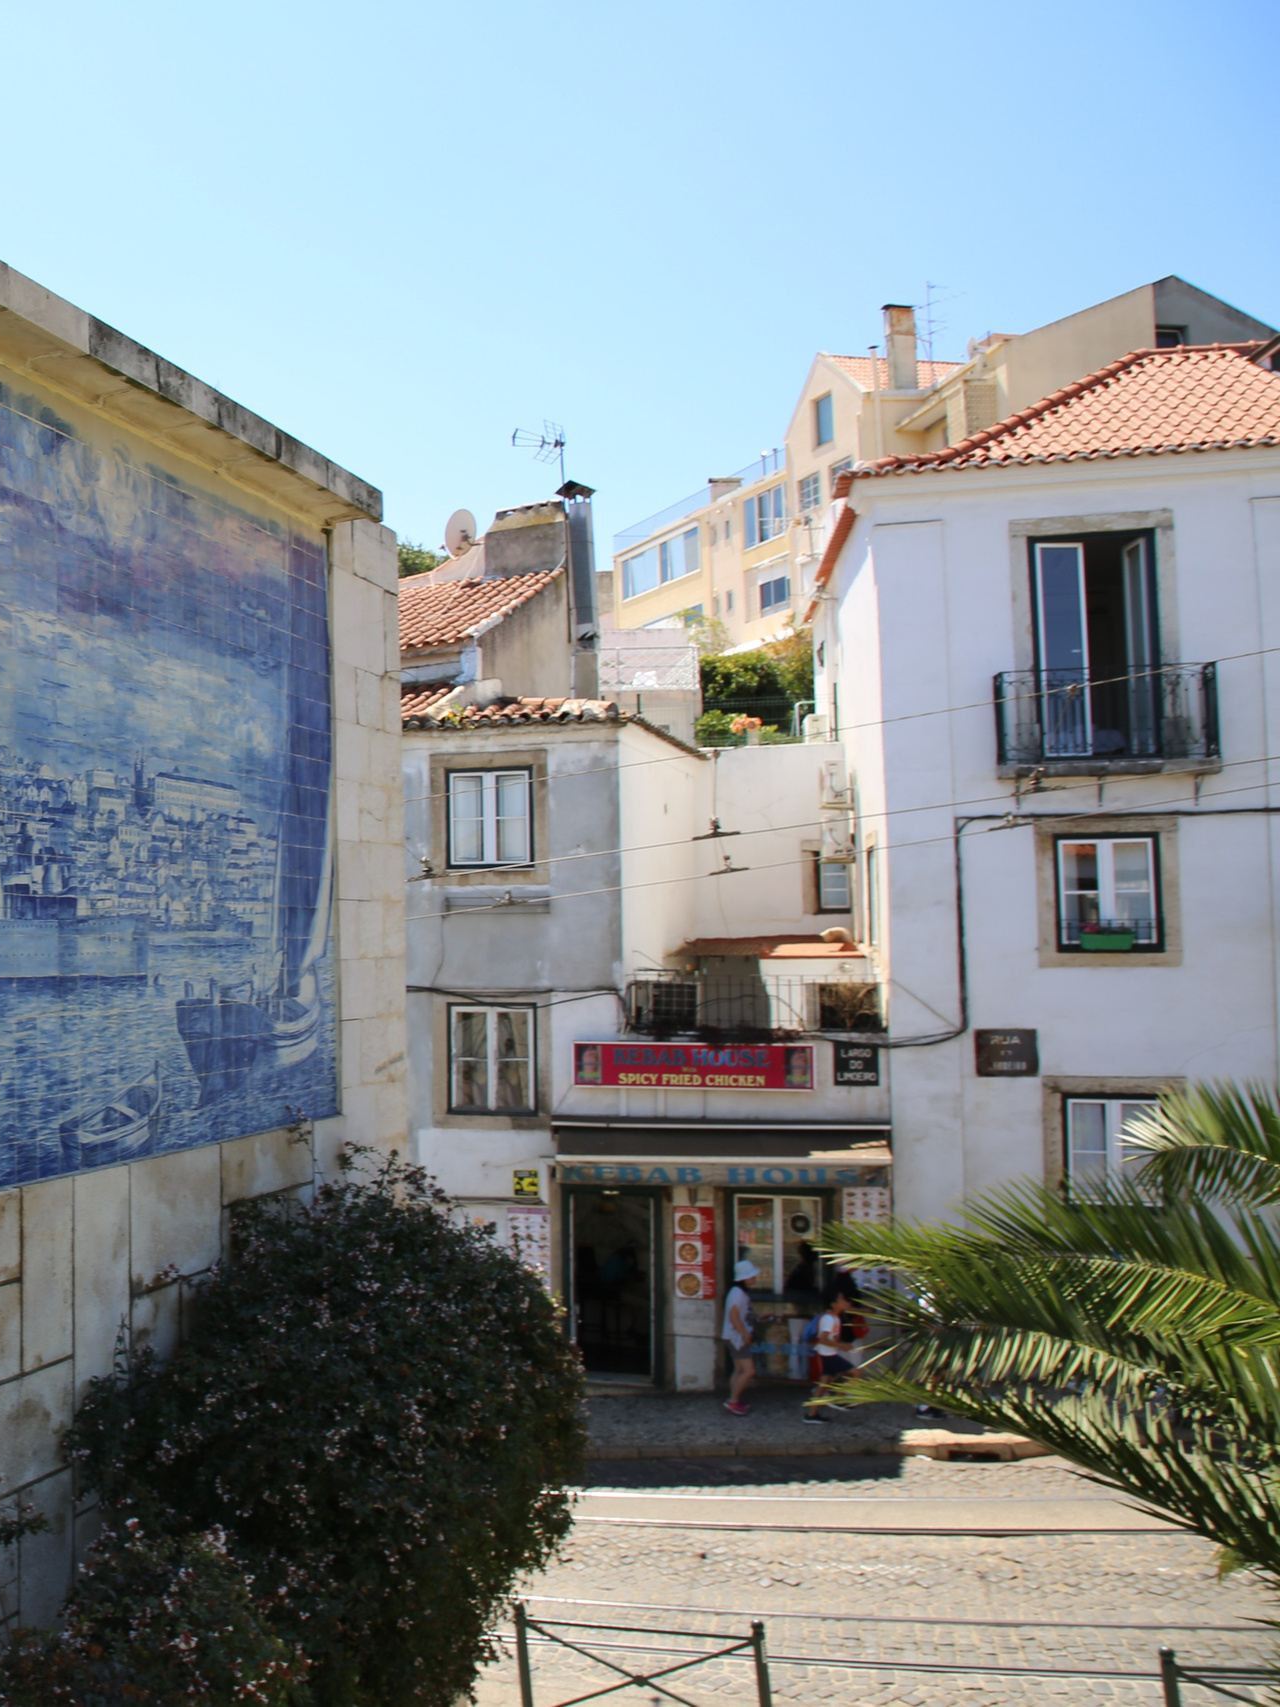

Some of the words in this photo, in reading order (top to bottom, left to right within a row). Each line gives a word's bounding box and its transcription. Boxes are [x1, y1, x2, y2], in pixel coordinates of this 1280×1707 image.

[614, 1048, 688, 1066] KEBAB
[692, 1048, 770, 1067] HOUSE
[841, 1049, 872, 1058] LARGO
[849, 1060, 864, 1070] DO
[618, 1073, 658, 1085] SPICY
[661, 1073, 702, 1086] FRIED
[705, 1074, 766, 1087] CHICKEN
[837, 1072, 877, 1081] LIMOEIRO
[561, 1165, 703, 1184] KEBAB
